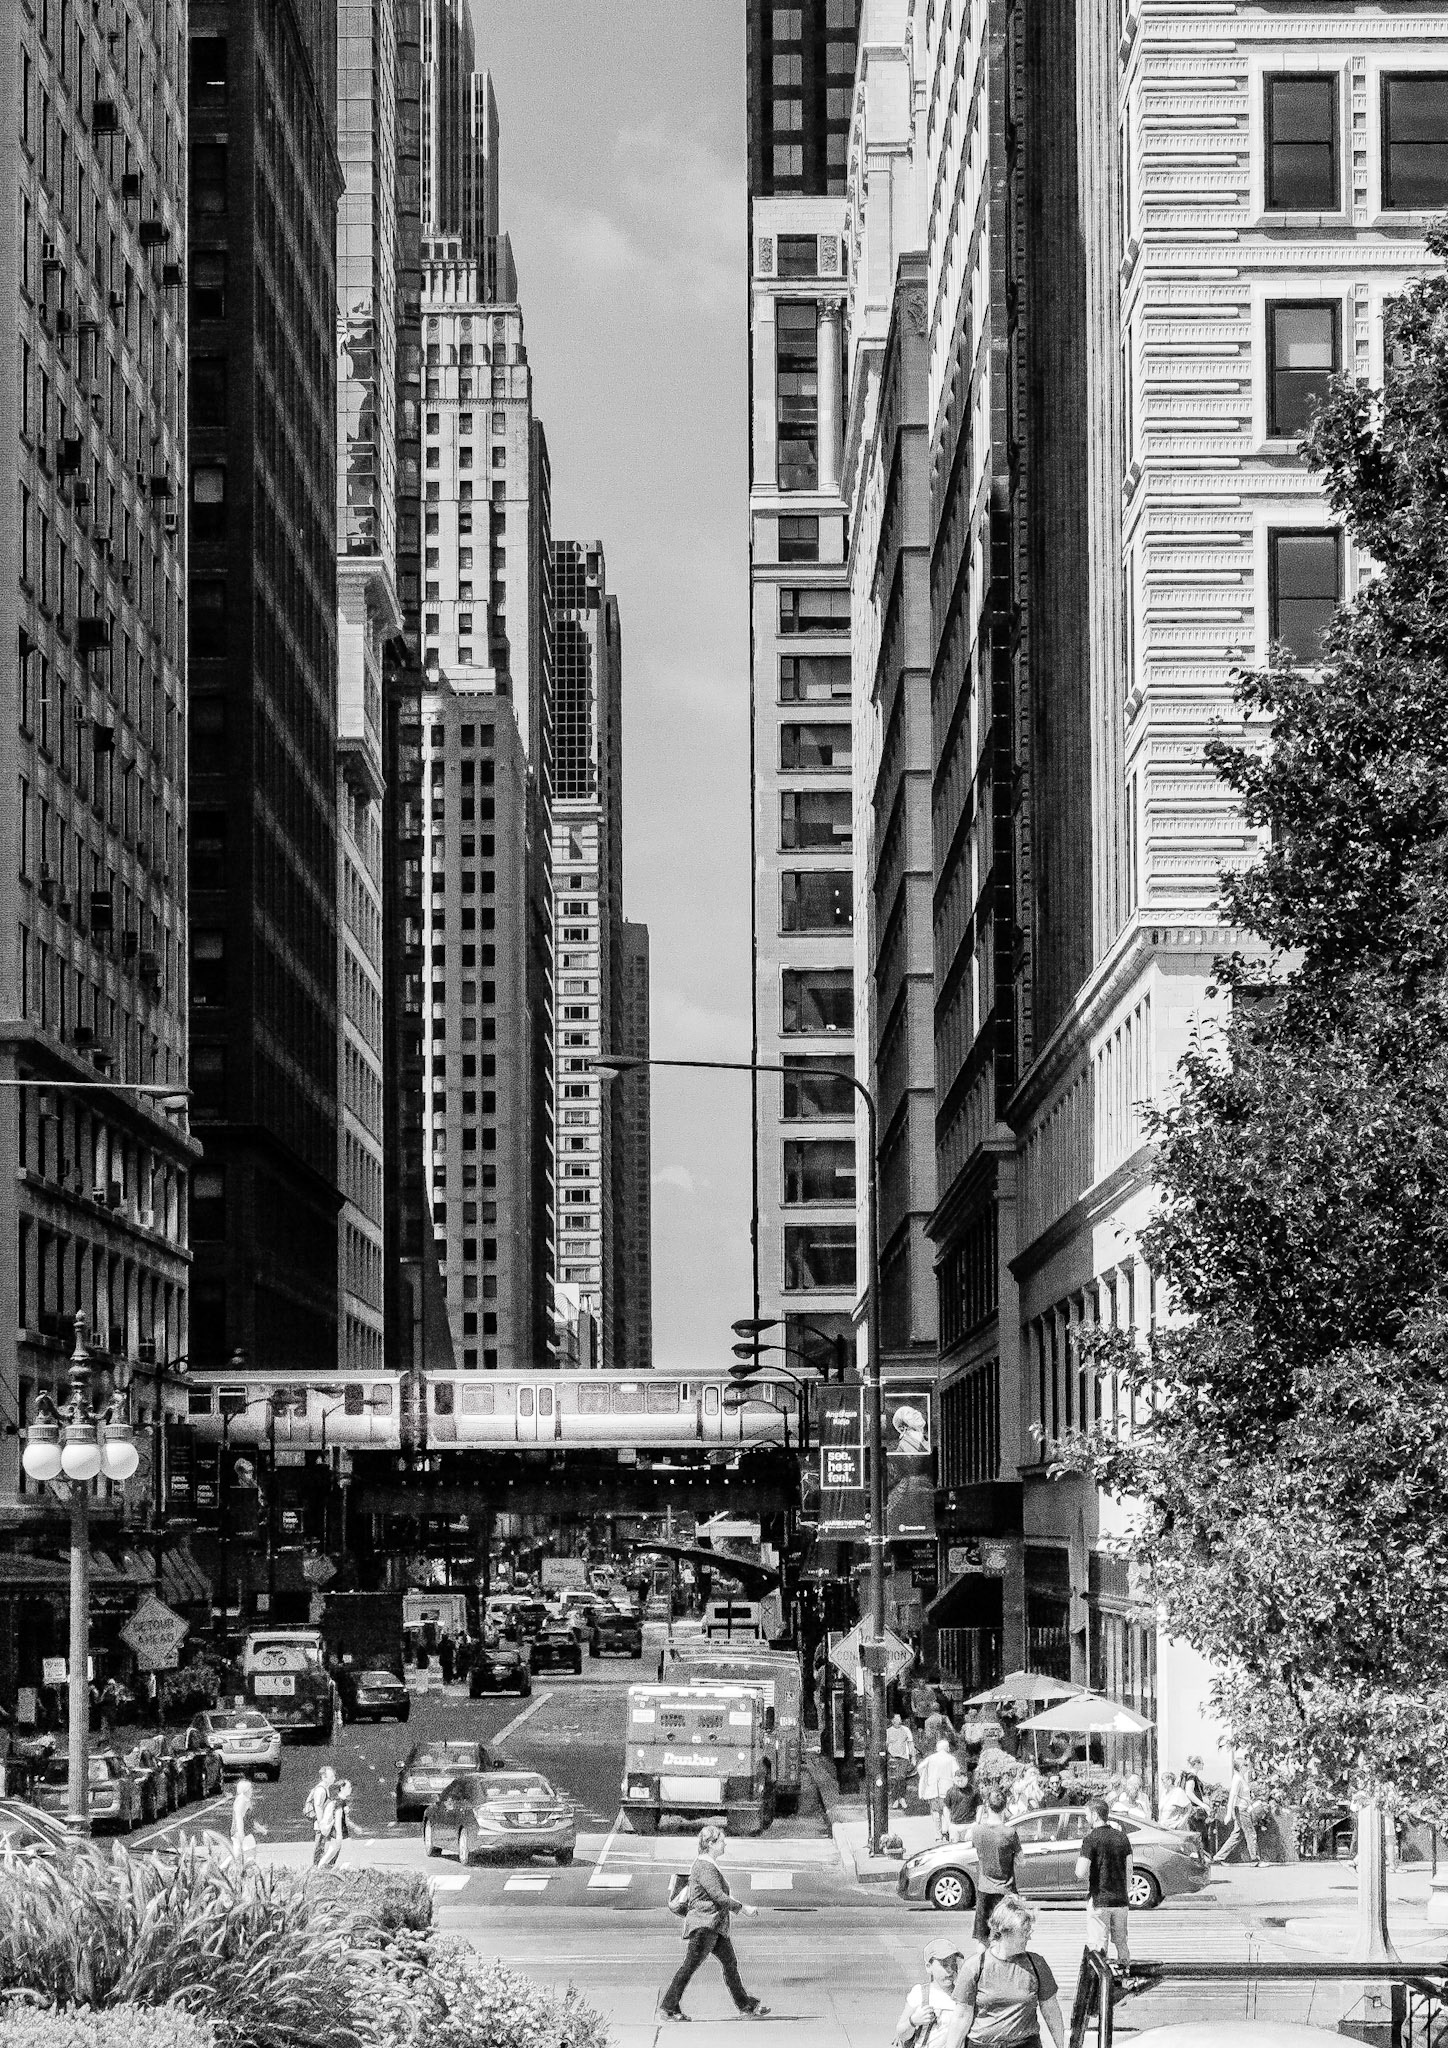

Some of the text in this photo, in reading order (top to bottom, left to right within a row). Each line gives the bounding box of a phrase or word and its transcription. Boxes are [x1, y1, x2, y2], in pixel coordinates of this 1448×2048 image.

[828, 1452, 851, 1461] see.
[828, 1461, 855, 1472] hear.
[828, 1472, 852, 1482] feel.
[133, 1618, 174, 1632] DETOUR
[137, 1632, 174, 1645] AHEAD
[662, 1752, 719, 1767] Dunbar
